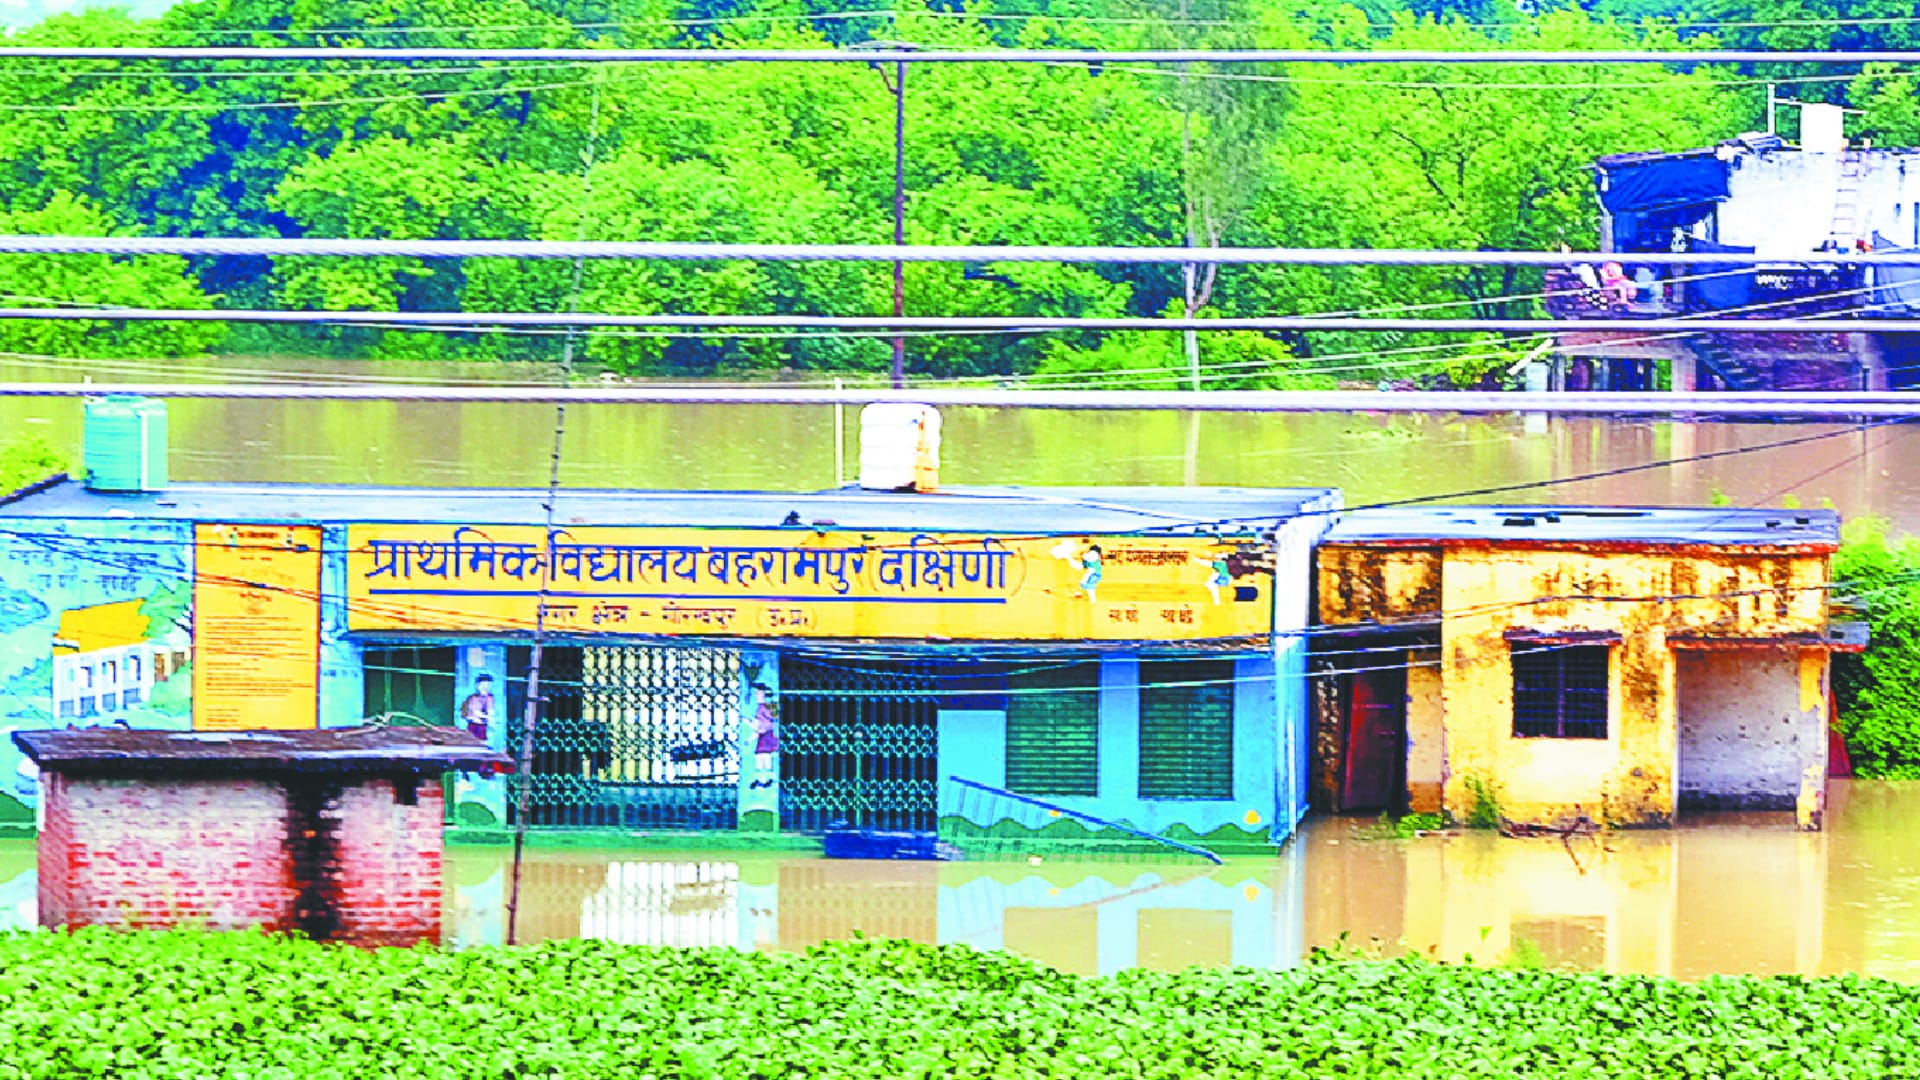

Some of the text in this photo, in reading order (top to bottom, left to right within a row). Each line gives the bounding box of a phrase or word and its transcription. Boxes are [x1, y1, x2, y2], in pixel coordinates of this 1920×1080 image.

[365, 526, 546, 580] प्राथमिक
[548, 529, 703, 583] विद्यालय
[708, 545, 868, 594] बहरामपुर
